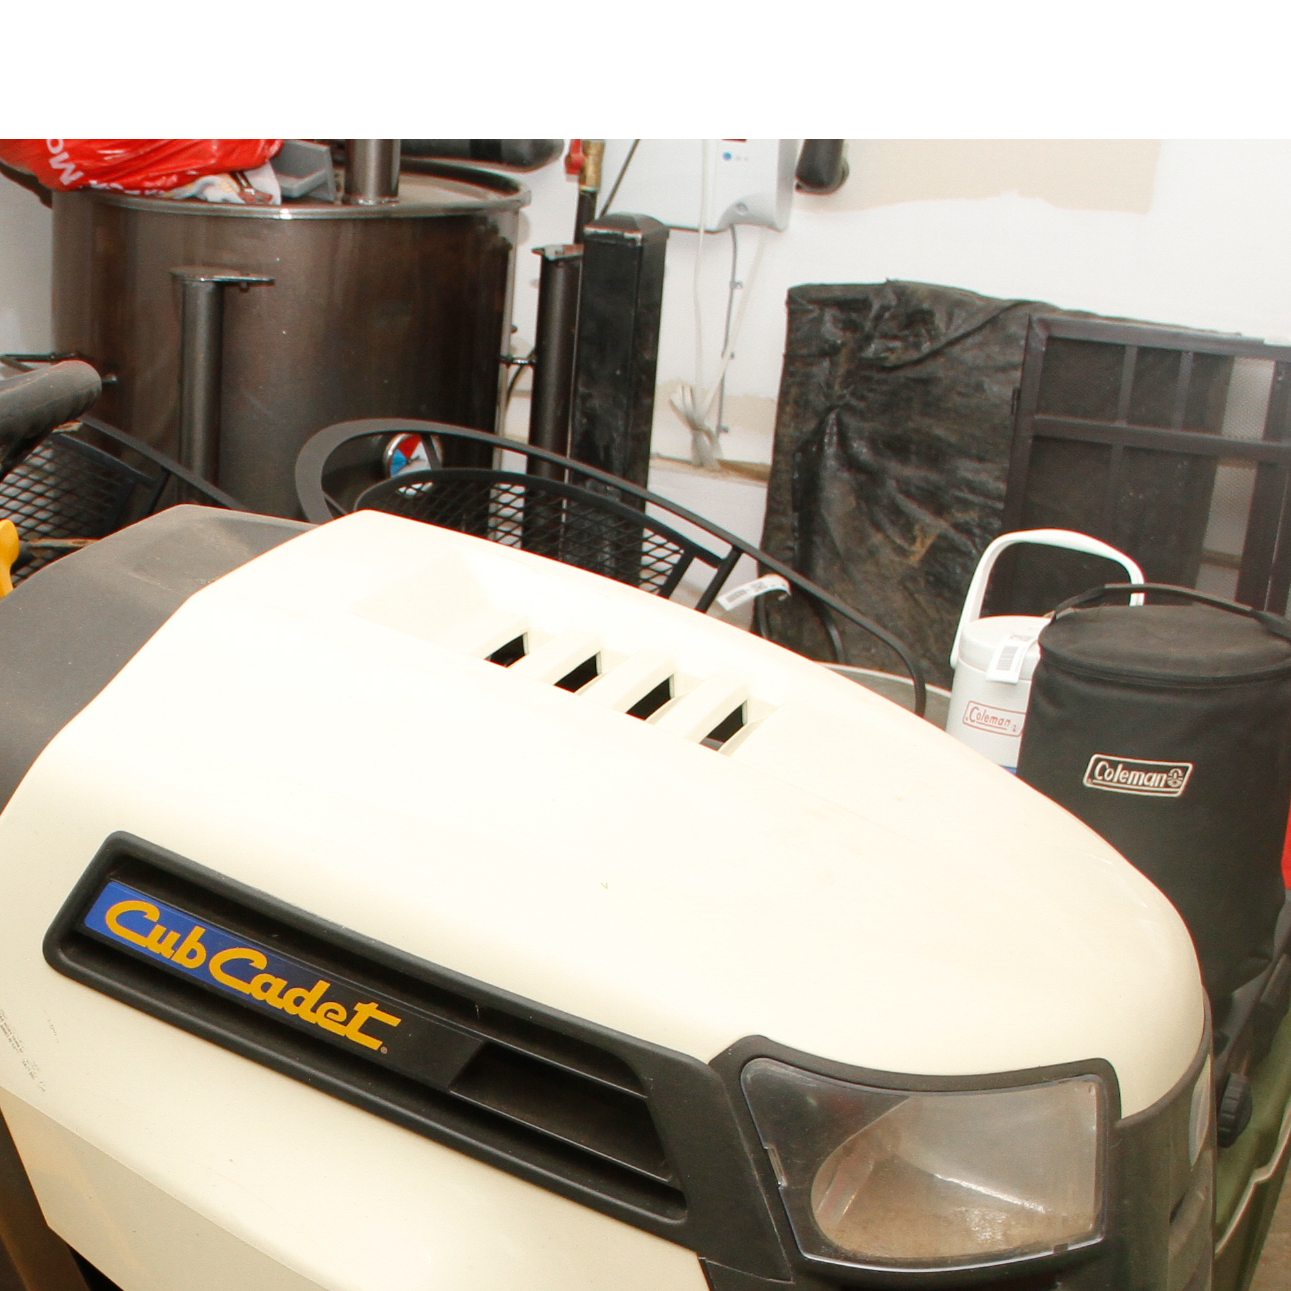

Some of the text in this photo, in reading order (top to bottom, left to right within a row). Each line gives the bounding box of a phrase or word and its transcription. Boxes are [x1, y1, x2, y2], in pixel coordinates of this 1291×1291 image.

[969, 706, 1011, 727] Coleman
[1094, 760, 1168, 788] Coleman
[105, 900, 402, 1051] Cub Cadet
